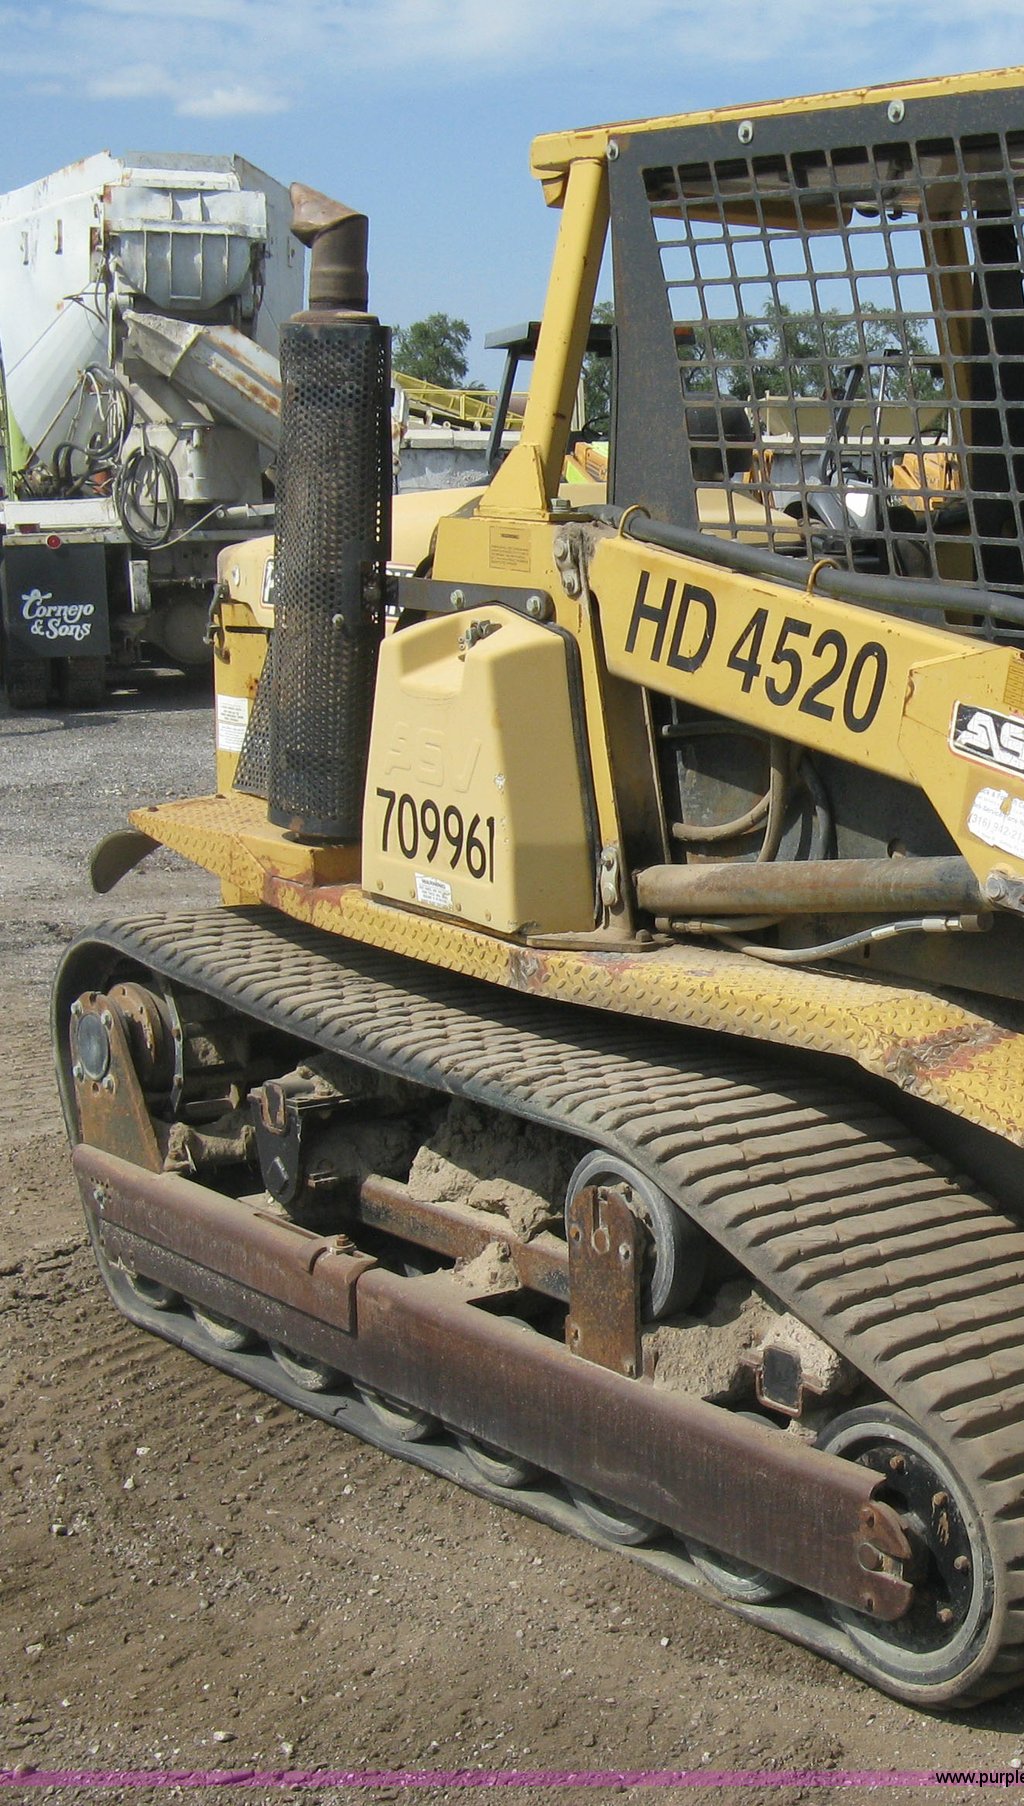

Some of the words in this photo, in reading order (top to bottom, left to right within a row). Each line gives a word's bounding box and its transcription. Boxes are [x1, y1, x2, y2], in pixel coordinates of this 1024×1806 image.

[22, 590, 95, 623] Cornejo
[31, 619, 44, 635] &
[46, 618, 92, 640] Sons
[624, 570, 716, 673] HD
[727, 607, 888, 733] 4520
[376, 787, 495, 883] 709961
